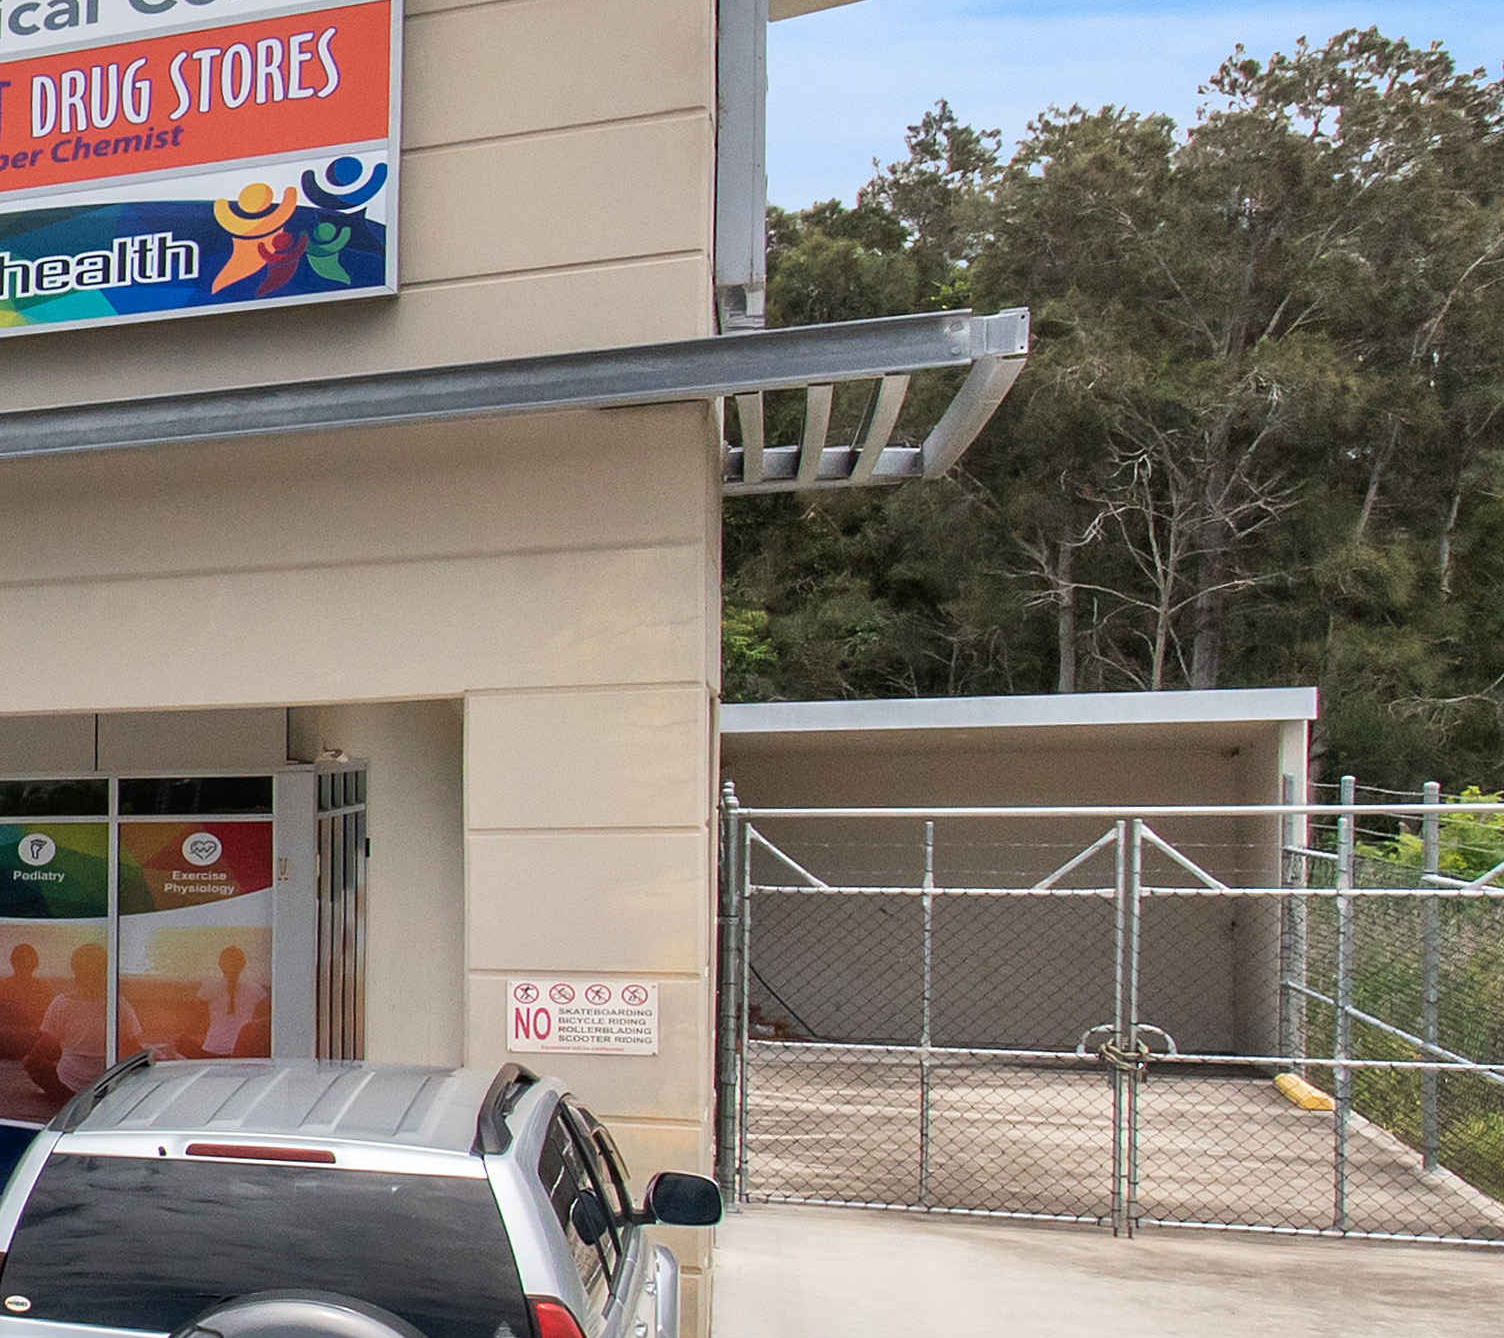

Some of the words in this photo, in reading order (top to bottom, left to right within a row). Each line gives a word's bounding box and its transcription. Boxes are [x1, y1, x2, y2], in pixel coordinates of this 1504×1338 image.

[30, 56, 152, 139] DRUG
[169, 27, 341, 121] STORES
[51, 126, 185, 163] Chemist
[13, 870, 65, 883] Podiatry
[172, 870, 228, 882] Exercise
[163, 883, 236, 896] Physiology
[558, 1007, 653, 1017] SKATEBOARDING
[514, 1007, 552, 1041] NO
[558, 1017, 605, 1025] BICYCLE
[608, 1018, 647, 1026] RIDING
[558, 1025, 653, 1035] ROLLERBLADING
[558, 1035, 611, 1044] SCOOTER
[614, 1035, 653, 1045] RIDING
